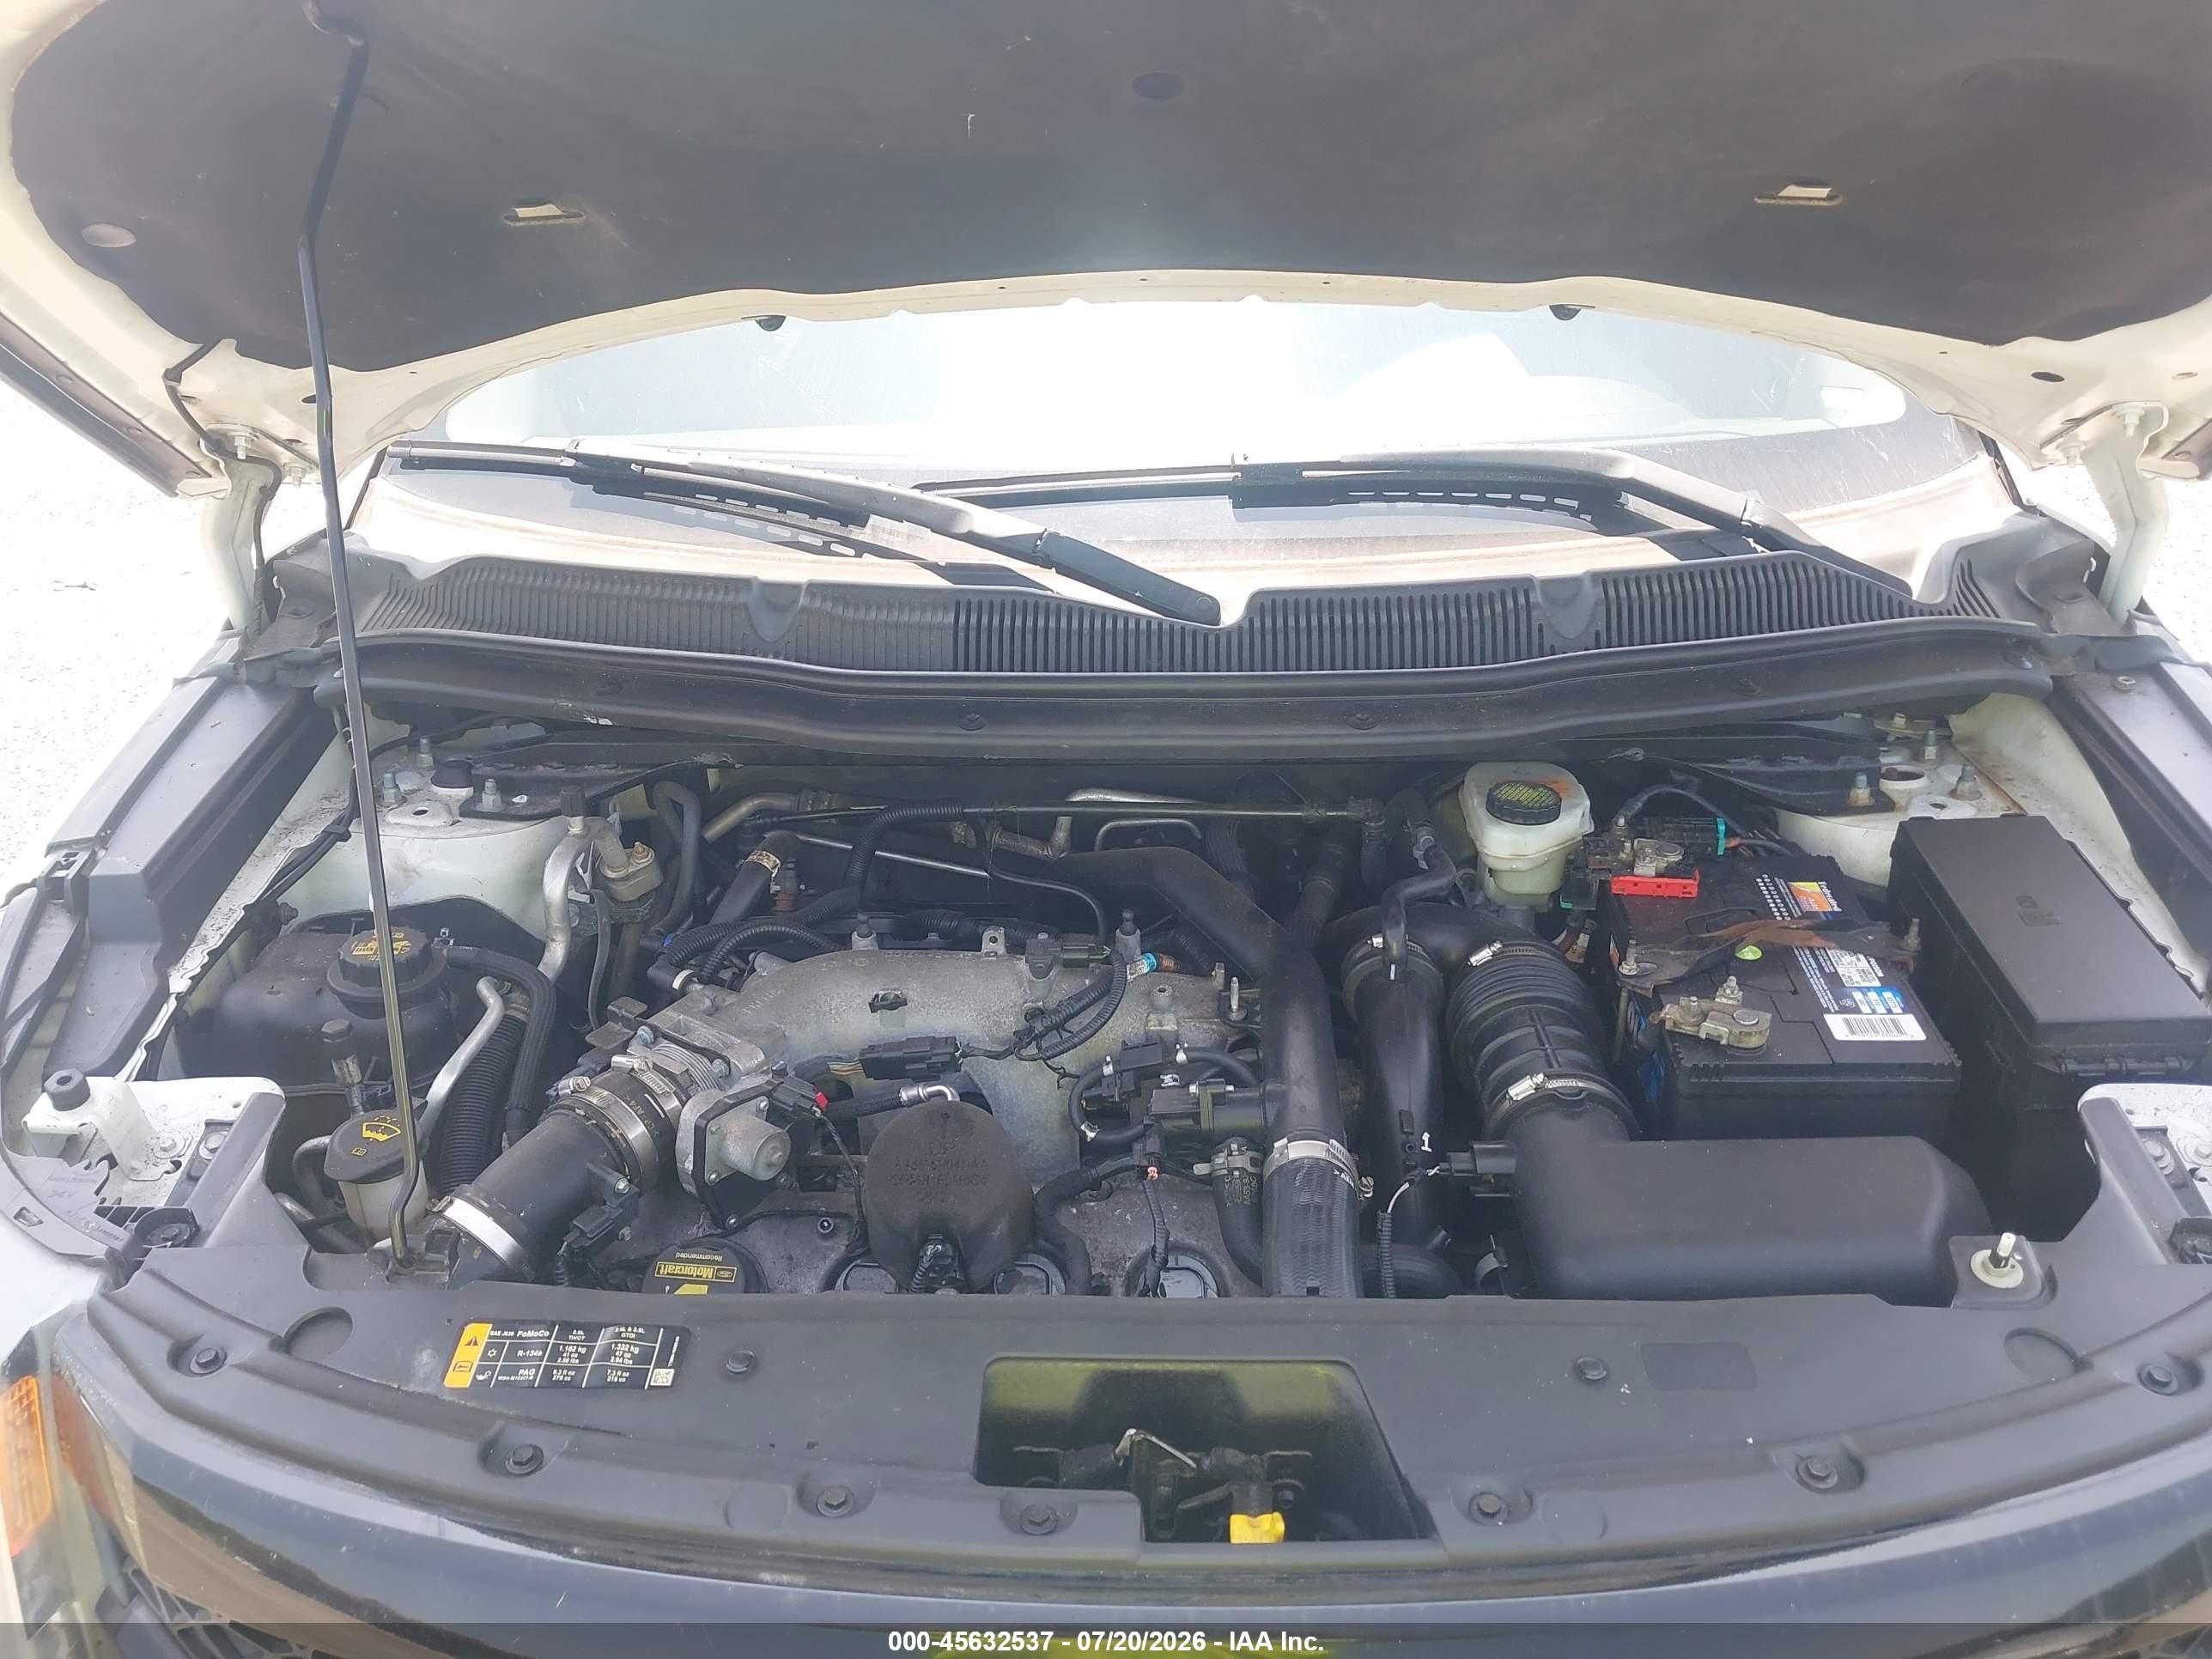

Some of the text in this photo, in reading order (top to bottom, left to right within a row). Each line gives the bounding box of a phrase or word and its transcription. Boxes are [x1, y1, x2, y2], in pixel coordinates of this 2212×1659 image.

[675, 1251, 723, 1261] Recommended
[659, 1263, 714, 1279] Motorcraft
[577, 1346, 587, 1354] kg
[611, 1343, 640, 1354] 1.332 kg
